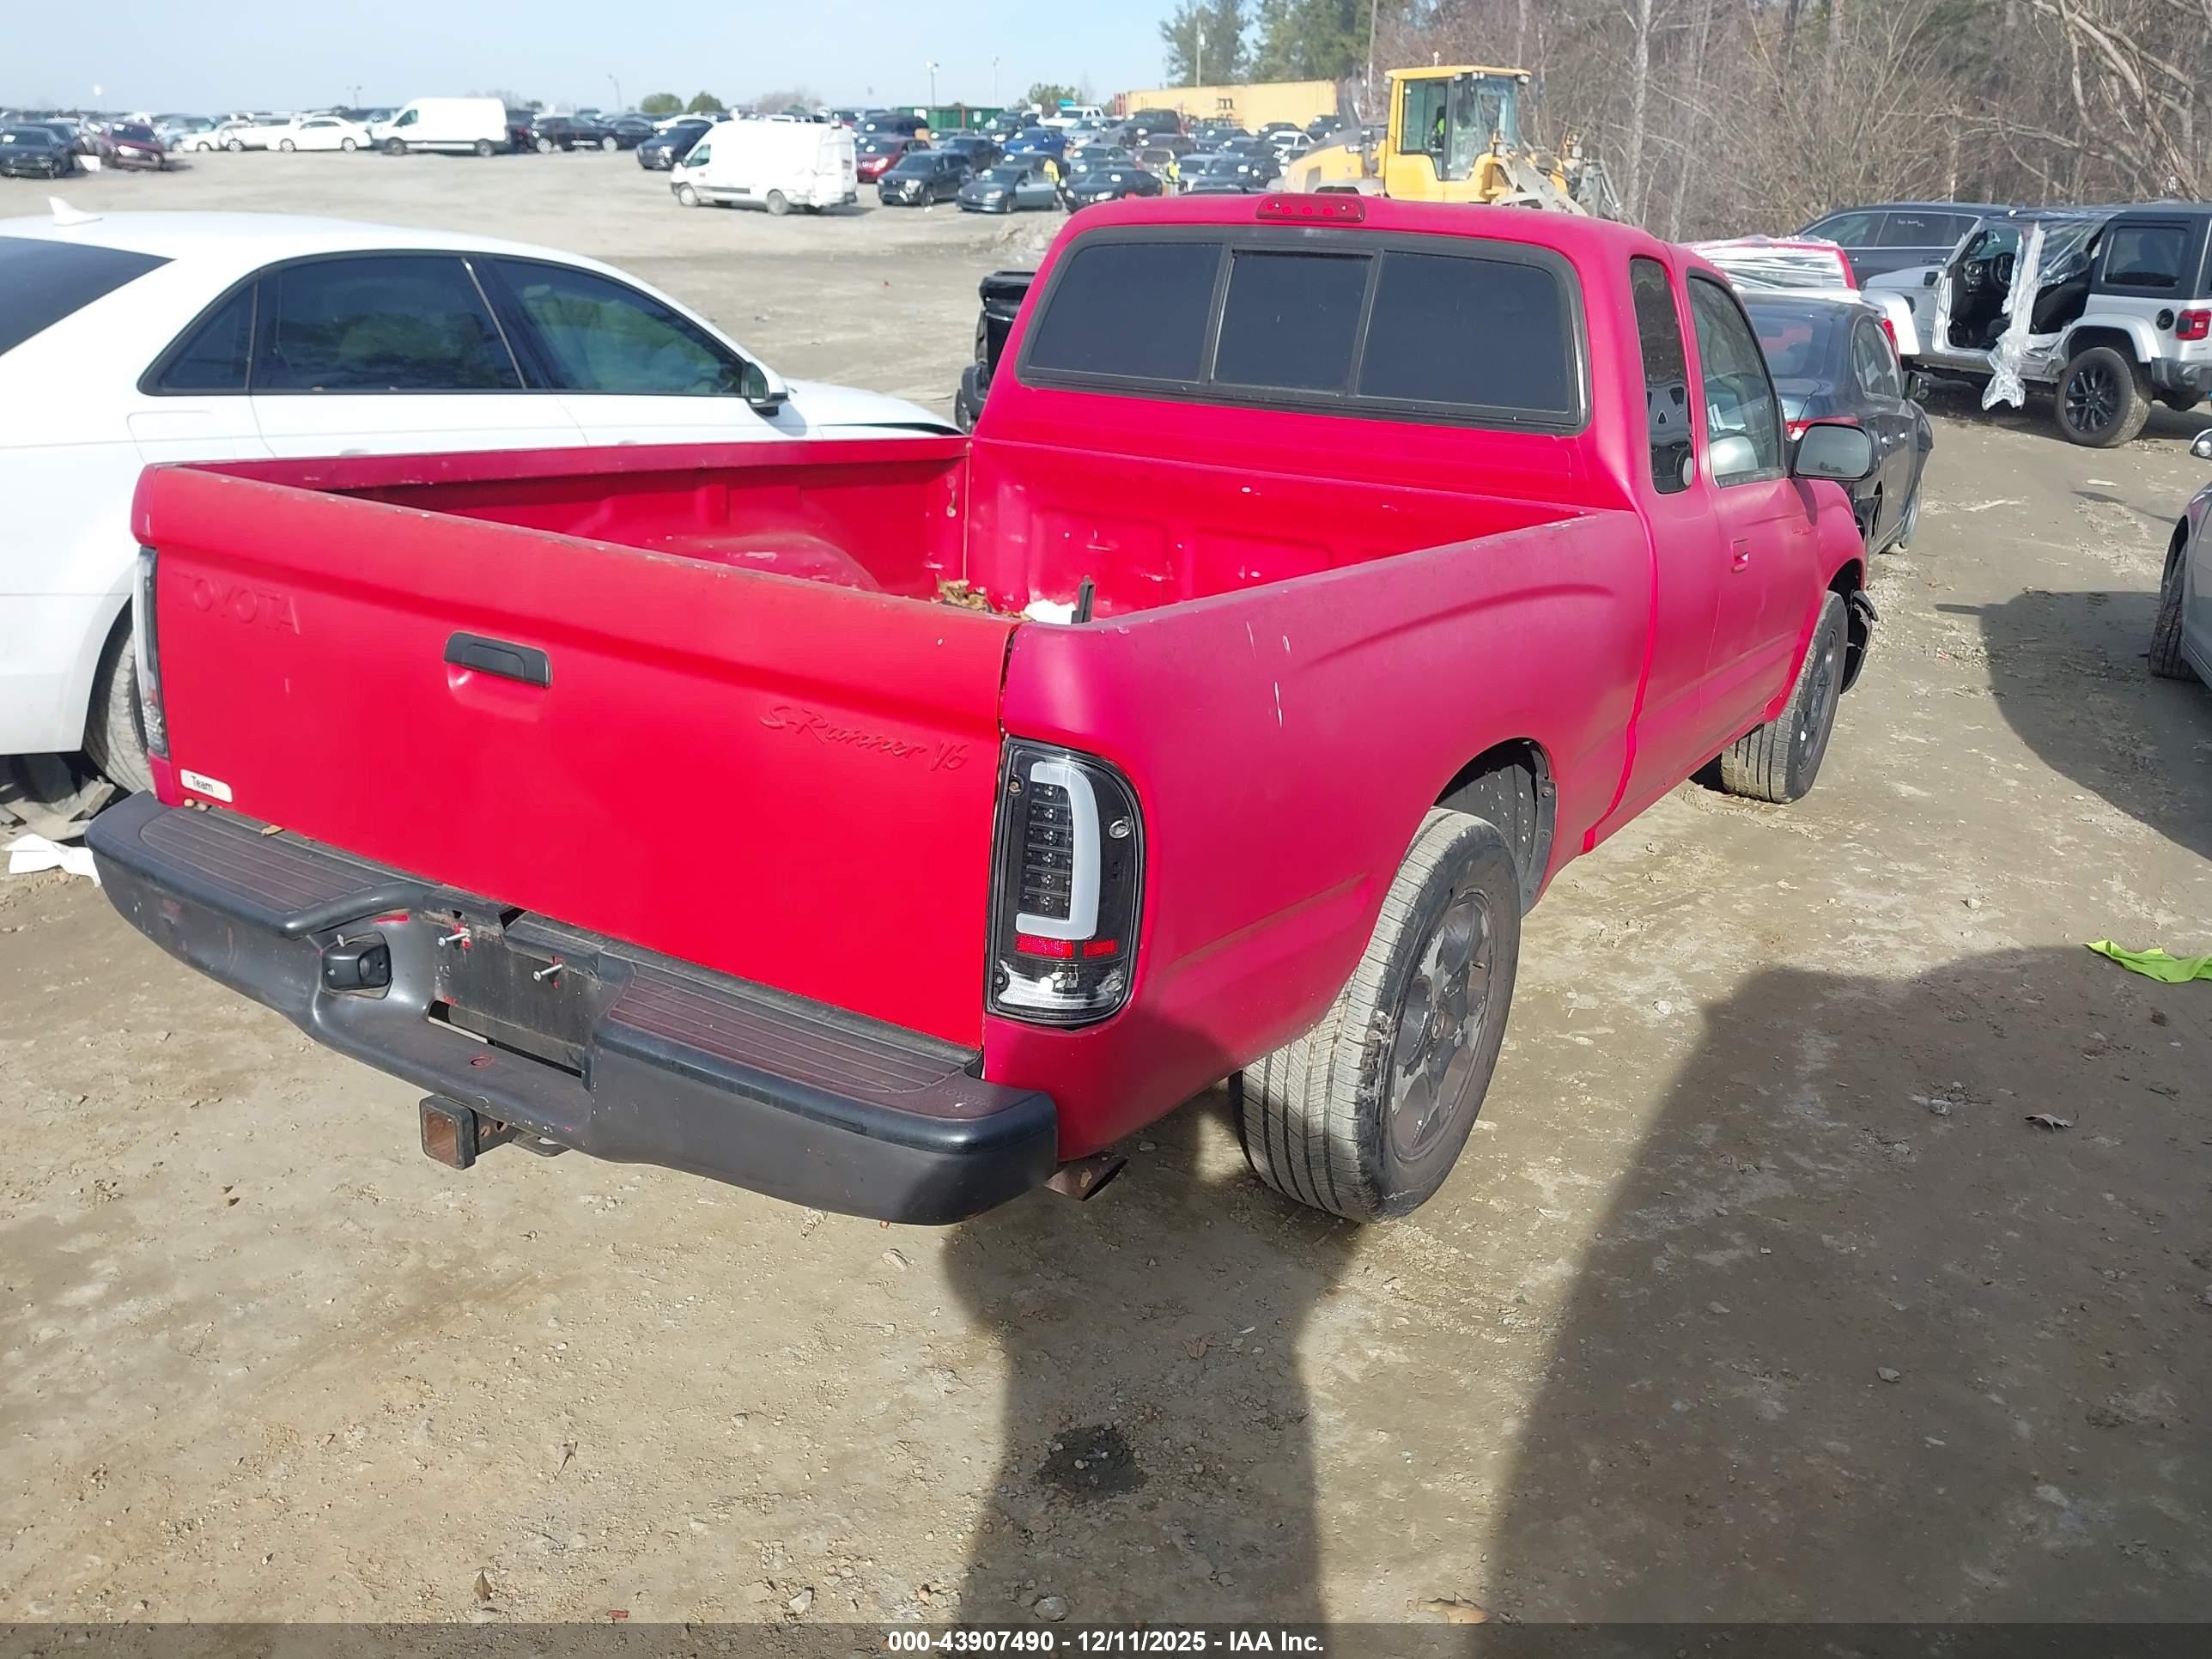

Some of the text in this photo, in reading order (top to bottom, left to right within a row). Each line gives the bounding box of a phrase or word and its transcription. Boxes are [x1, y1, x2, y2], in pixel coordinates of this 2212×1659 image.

[173, 572, 301, 635] TOYOTA
[759, 706, 969, 771] S-Runner V6
[190, 775, 214, 793] Team
